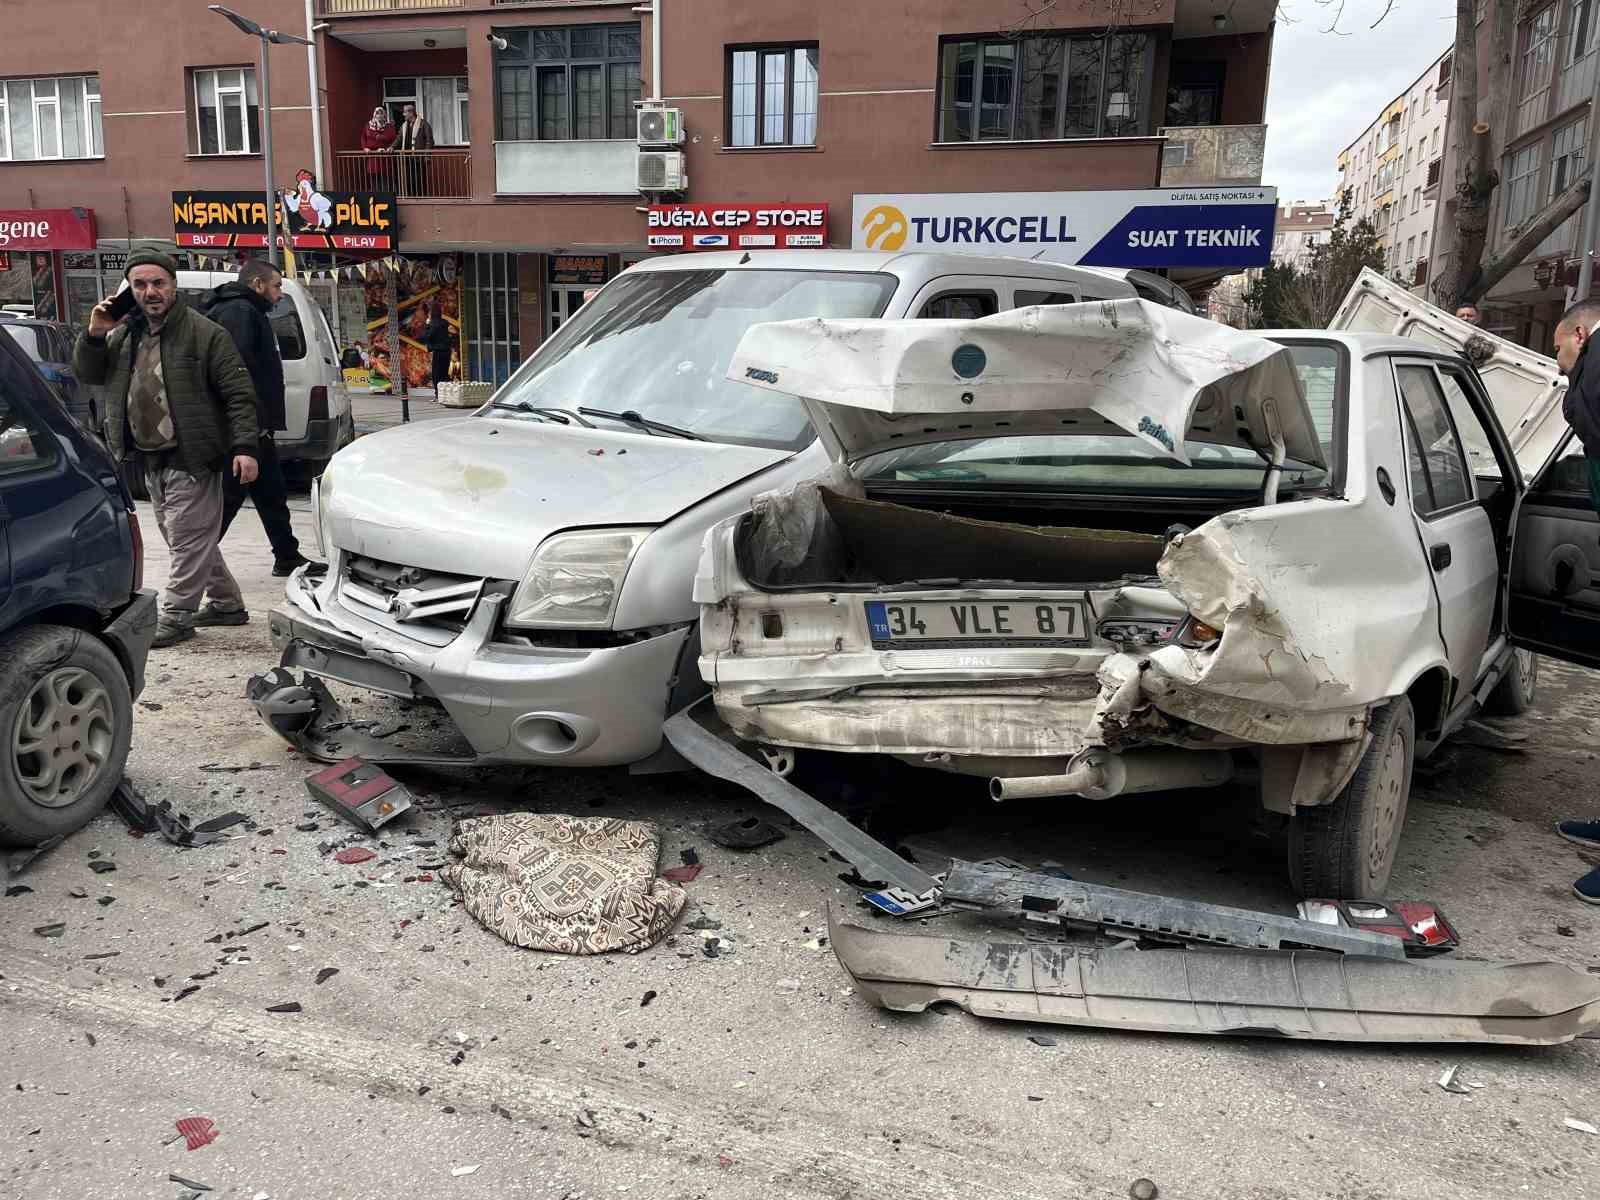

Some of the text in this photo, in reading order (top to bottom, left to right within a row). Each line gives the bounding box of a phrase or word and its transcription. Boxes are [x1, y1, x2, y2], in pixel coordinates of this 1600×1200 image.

[336, 196, 390, 230] PİLİÇ
[648, 206, 824, 226] BUĞRA CEP STORE
[911, 215, 1077, 243] TURKCELL
[1127, 224, 1262, 248] SUAT TEKNİK
[193, 235, 216, 245] BUT
[262, 236, 299, 246] KNT
[343, 237, 376, 247] PILAV
[874, 623, 889, 633] TR
[887, 605, 1076, 635] 34 VLE 87
